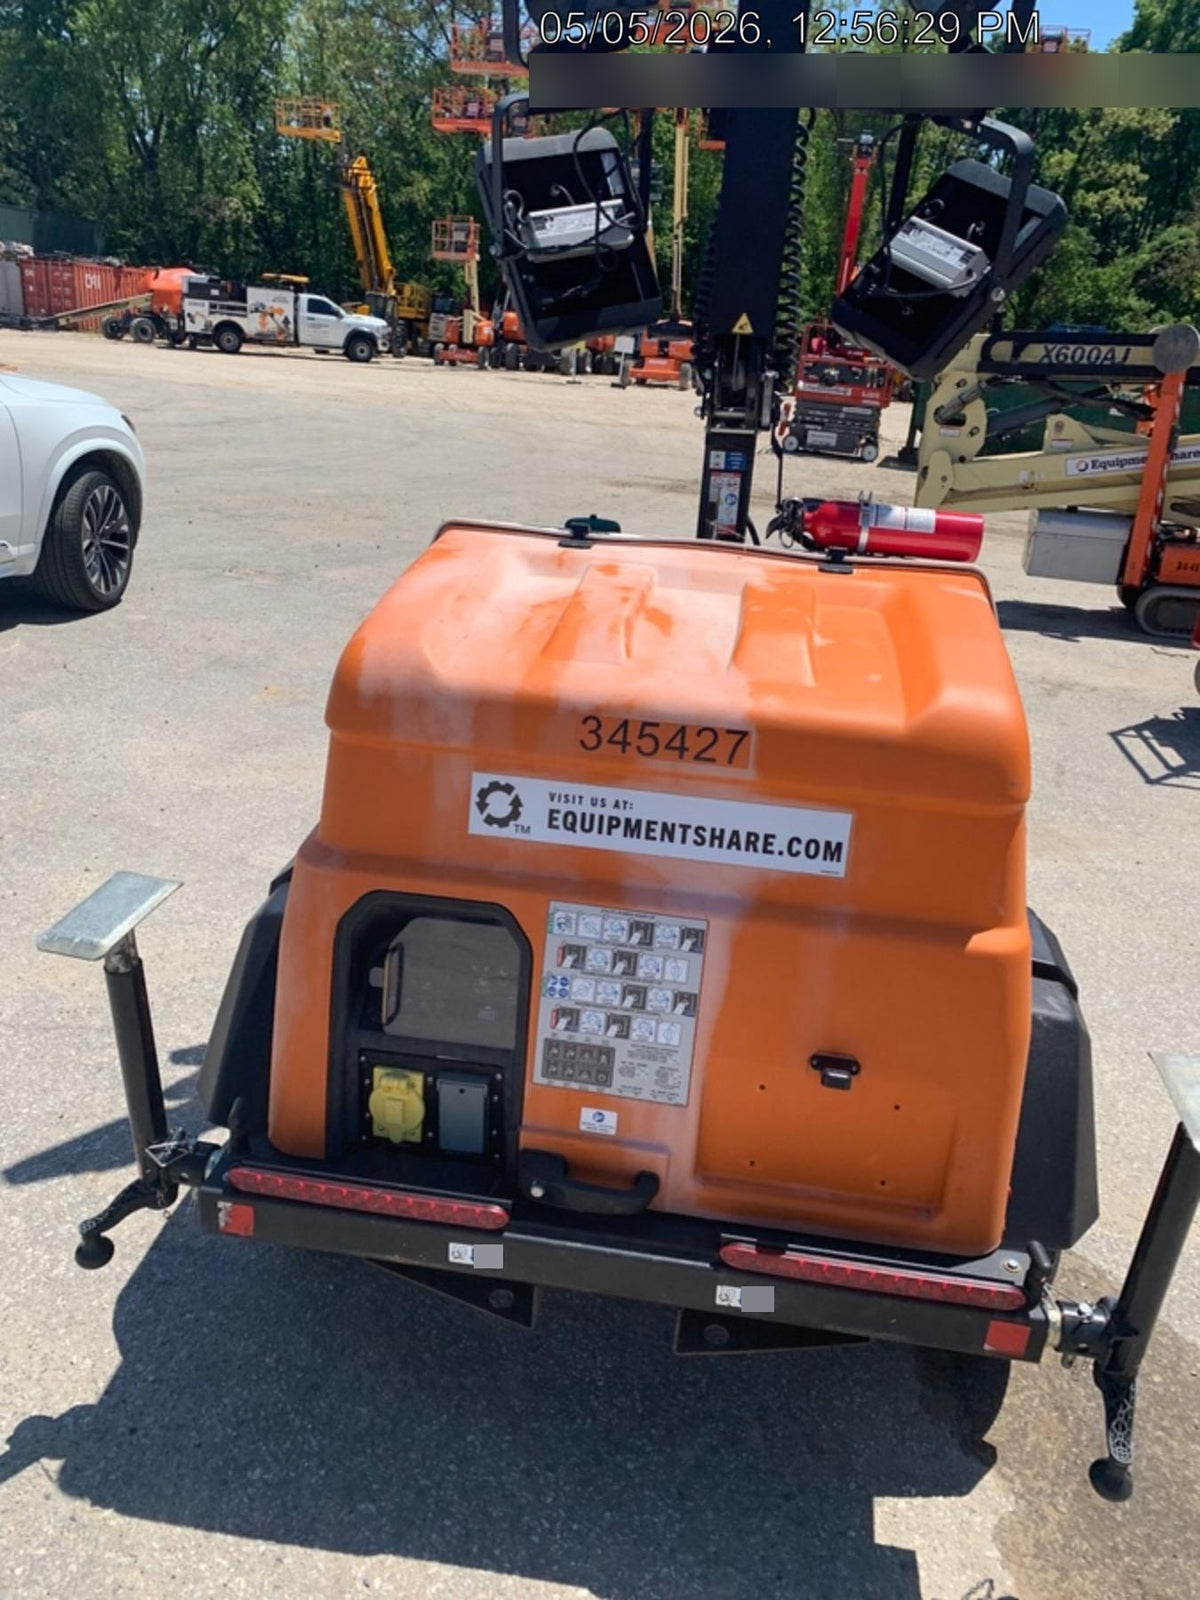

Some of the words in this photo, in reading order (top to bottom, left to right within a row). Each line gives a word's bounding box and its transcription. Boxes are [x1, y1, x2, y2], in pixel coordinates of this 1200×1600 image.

[579, 715, 749, 765] 345427
[549, 792, 583, 805] VISIT
[590, 797, 607, 808] US
[613, 800, 633, 810] AT:
[547, 808, 843, 863] EQUIPMENTSHARE.COM
